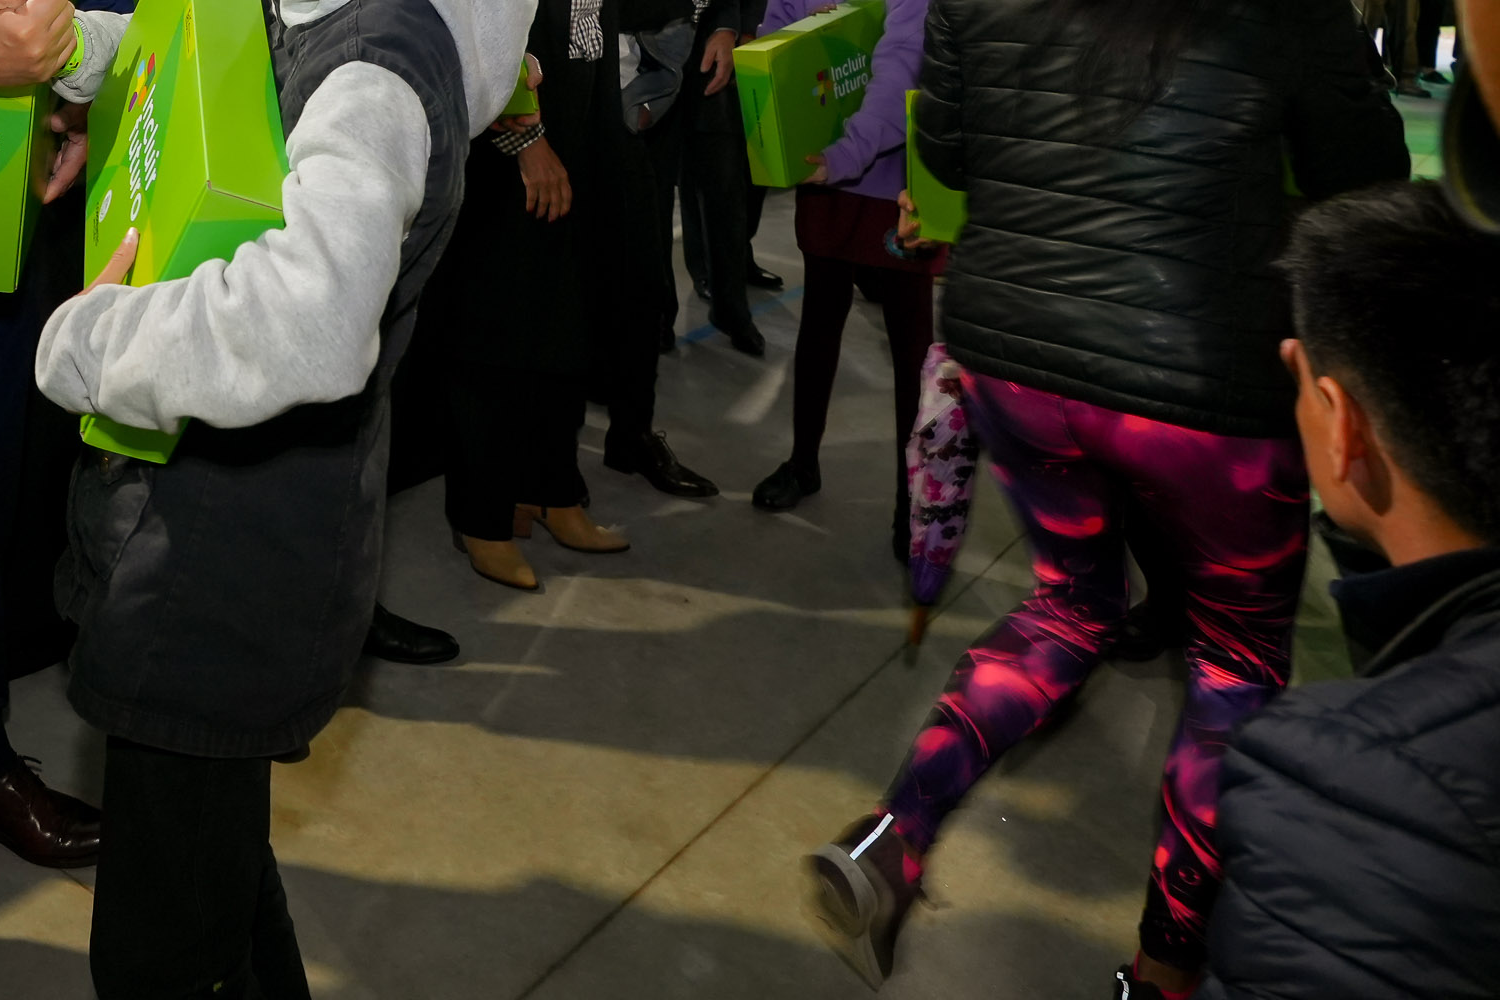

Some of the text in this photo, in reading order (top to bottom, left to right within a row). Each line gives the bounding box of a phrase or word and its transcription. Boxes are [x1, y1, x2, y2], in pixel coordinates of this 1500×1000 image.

[830, 53, 866, 82] Incluir
[833, 72, 869, 99] futuro
[128, 114, 143, 222] futuro
[142, 83, 160, 191] Incluir
